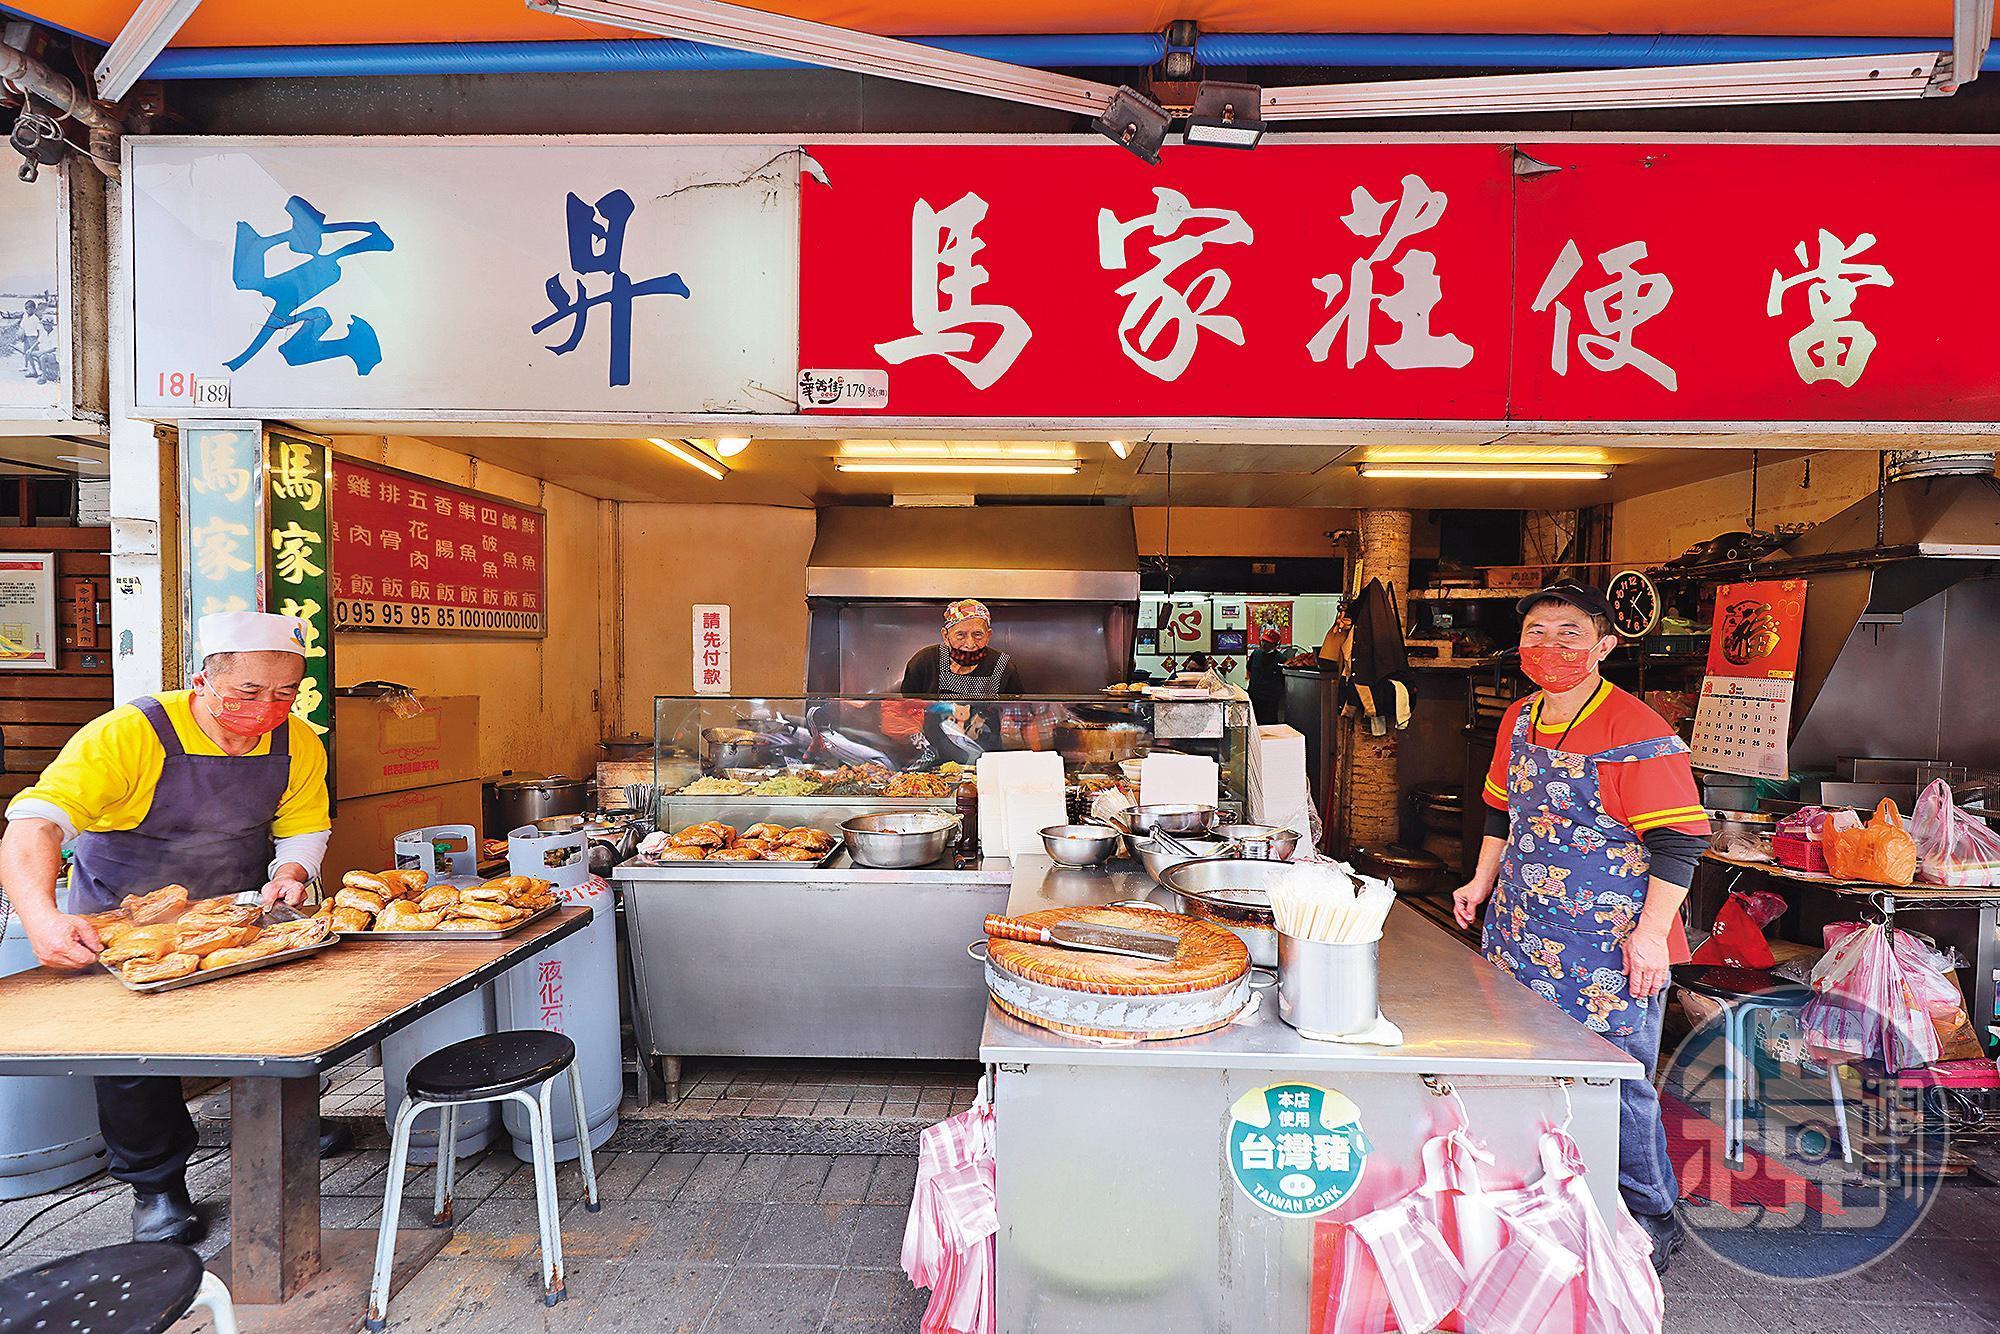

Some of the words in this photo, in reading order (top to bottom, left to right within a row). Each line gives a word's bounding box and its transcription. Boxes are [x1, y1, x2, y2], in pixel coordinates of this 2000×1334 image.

[222, 189, 690, 387] 宏昇
[874, 173, 1895, 392] 馬家莊便當
[159, 372, 194, 397] 181
[200, 384, 228, 403] 189
[846, 383, 866, 397] 179
[193, 434, 252, 614] 馬家
[347, 474, 375, 597] 雞肉飯
[379, 482, 404, 599] 排骨飯
[408, 489, 431, 601] 五花肉飯
[434, 495, 456, 603] 香腸飯
[1621, 581, 1628, 589] 11
[1628, 576, 1637, 585] 12
[1641, 580, 1644, 588] 1
[1615, 601, 1620, 609] 9
[1616, 590, 1624, 598] 10
[352, 602, 375, 623] 95
[382, 603, 403, 625] 95
[411, 605, 430, 626] 95
[437, 608, 455, 627] 85
[459, 609, 481, 628] 100
[481, 610, 501, 628] 100
[502, 611, 521, 629] 100
[521, 612, 538, 629] 100
[1619, 612, 1624, 621] 8
[1626, 619, 1631, 628] 7
[1634, 622, 1639, 631] 6
[703, 612, 721, 684] 請先付款
[1729, 682, 1737, 695] 3
[538, 960, 564, 1034] 液化石
[1277, 1091, 1310, 1109] 本店
[1277, 1110, 1310, 1128] 使用
[1239, 1132, 1351, 1172] 台灣豬
[1253, 1183, 1303, 1212] TAIWAN
[1306, 1184, 1343, 1211] PORK
